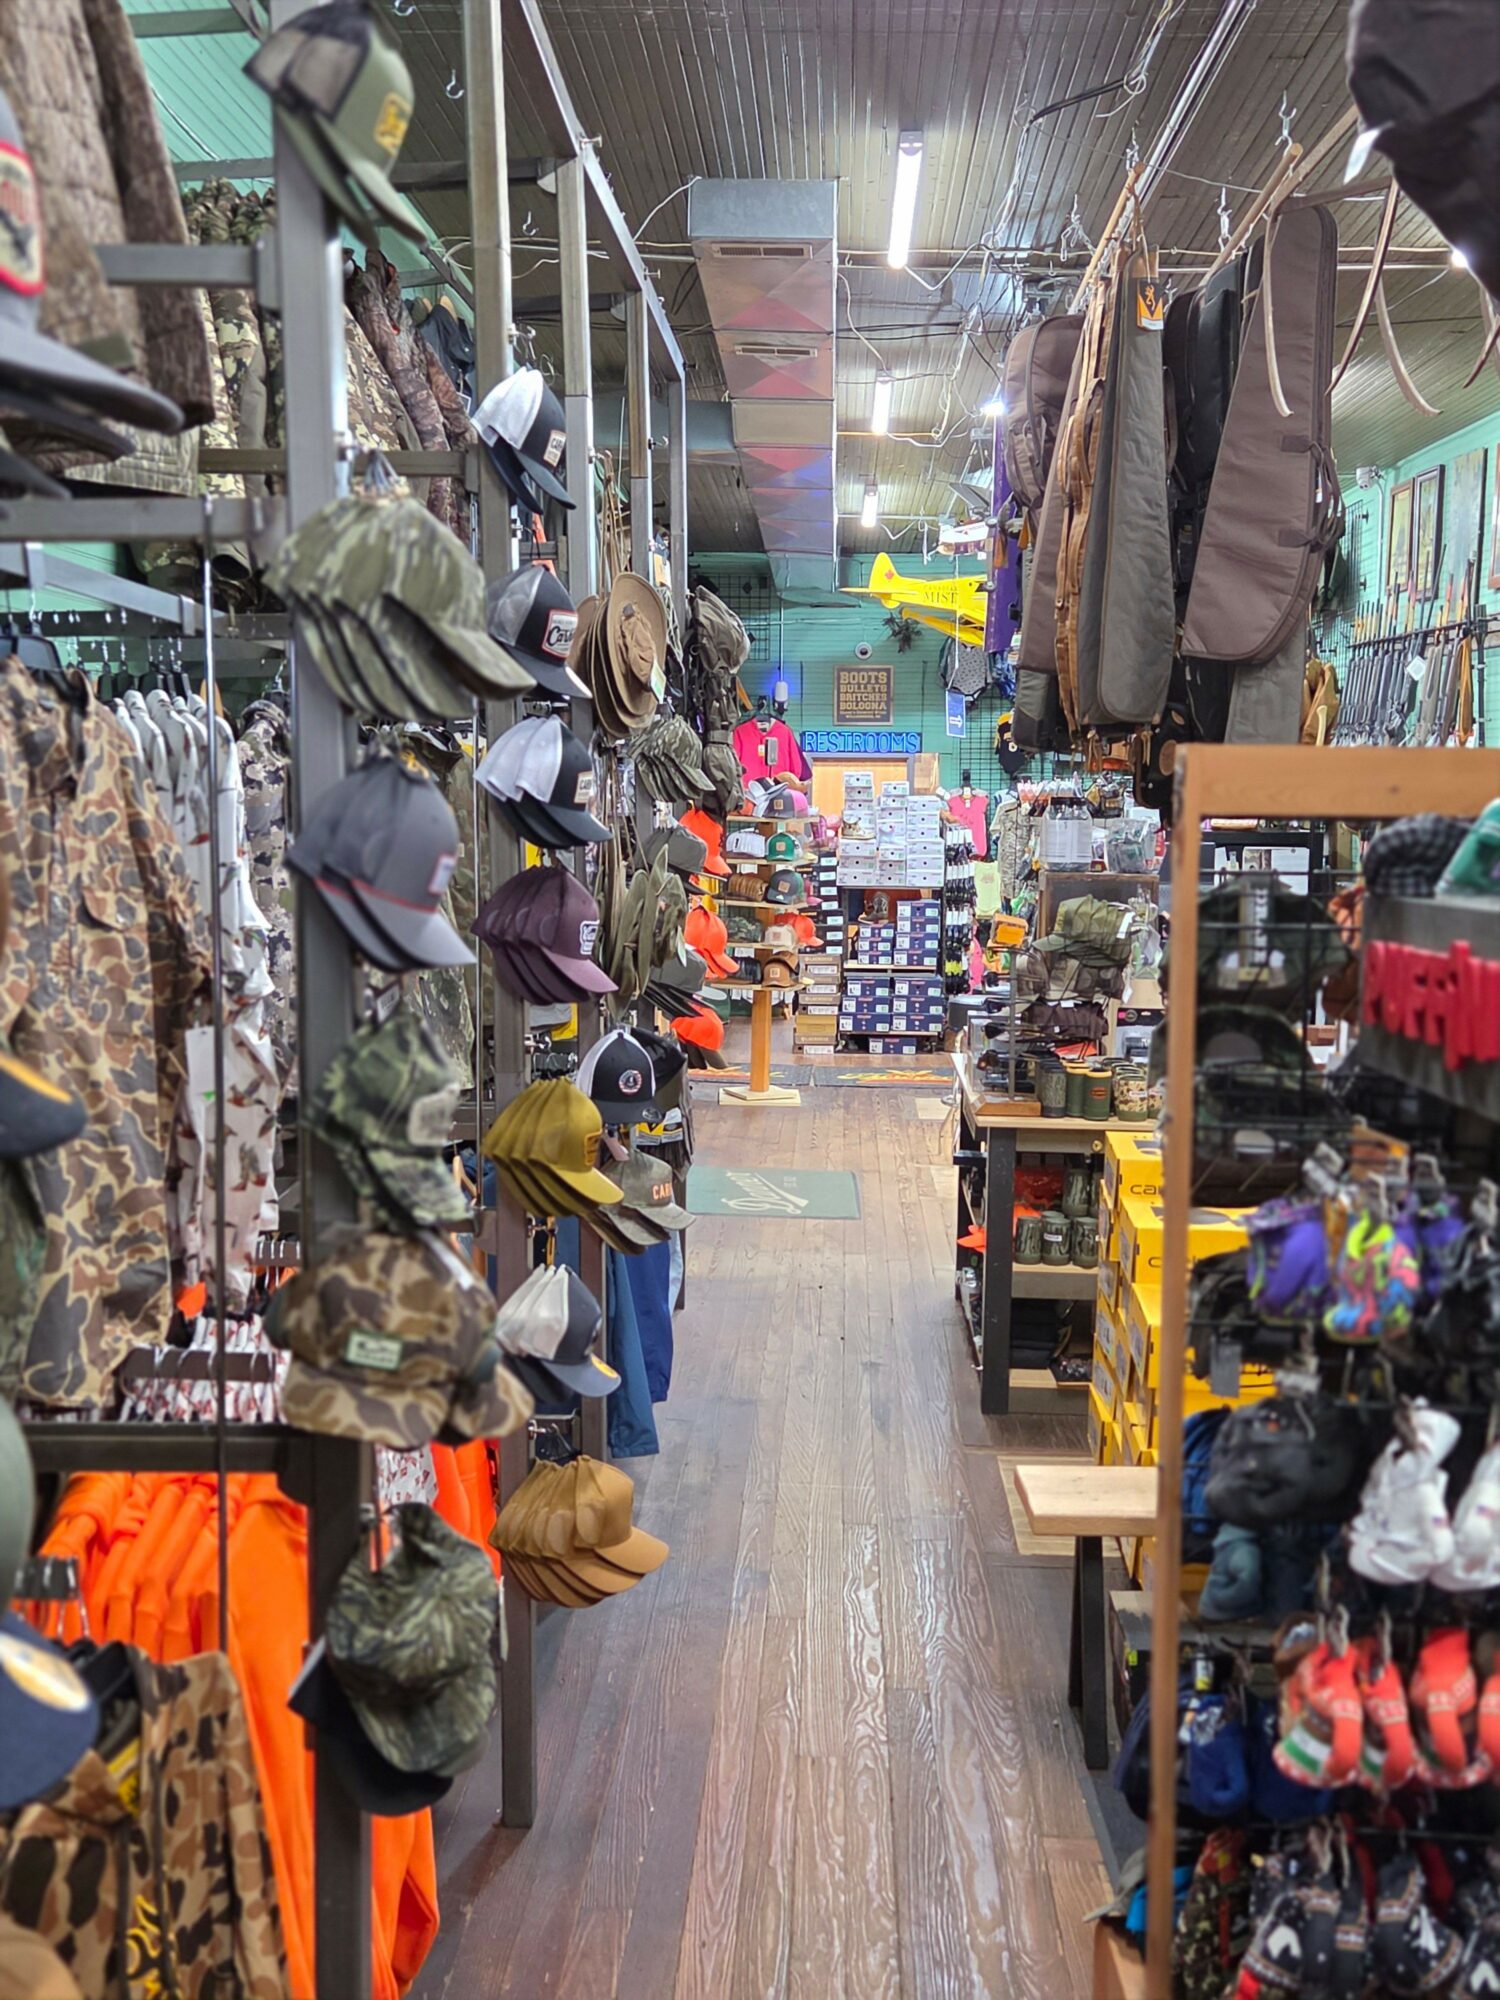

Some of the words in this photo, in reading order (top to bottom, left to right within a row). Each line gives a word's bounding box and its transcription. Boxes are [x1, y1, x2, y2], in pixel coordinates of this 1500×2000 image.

[923, 591, 959, 604] MIST
[840, 671, 887, 684] BOOTS
[840, 684, 887, 692] BULLETS
[804, 731, 919, 753] RESTROOMS
